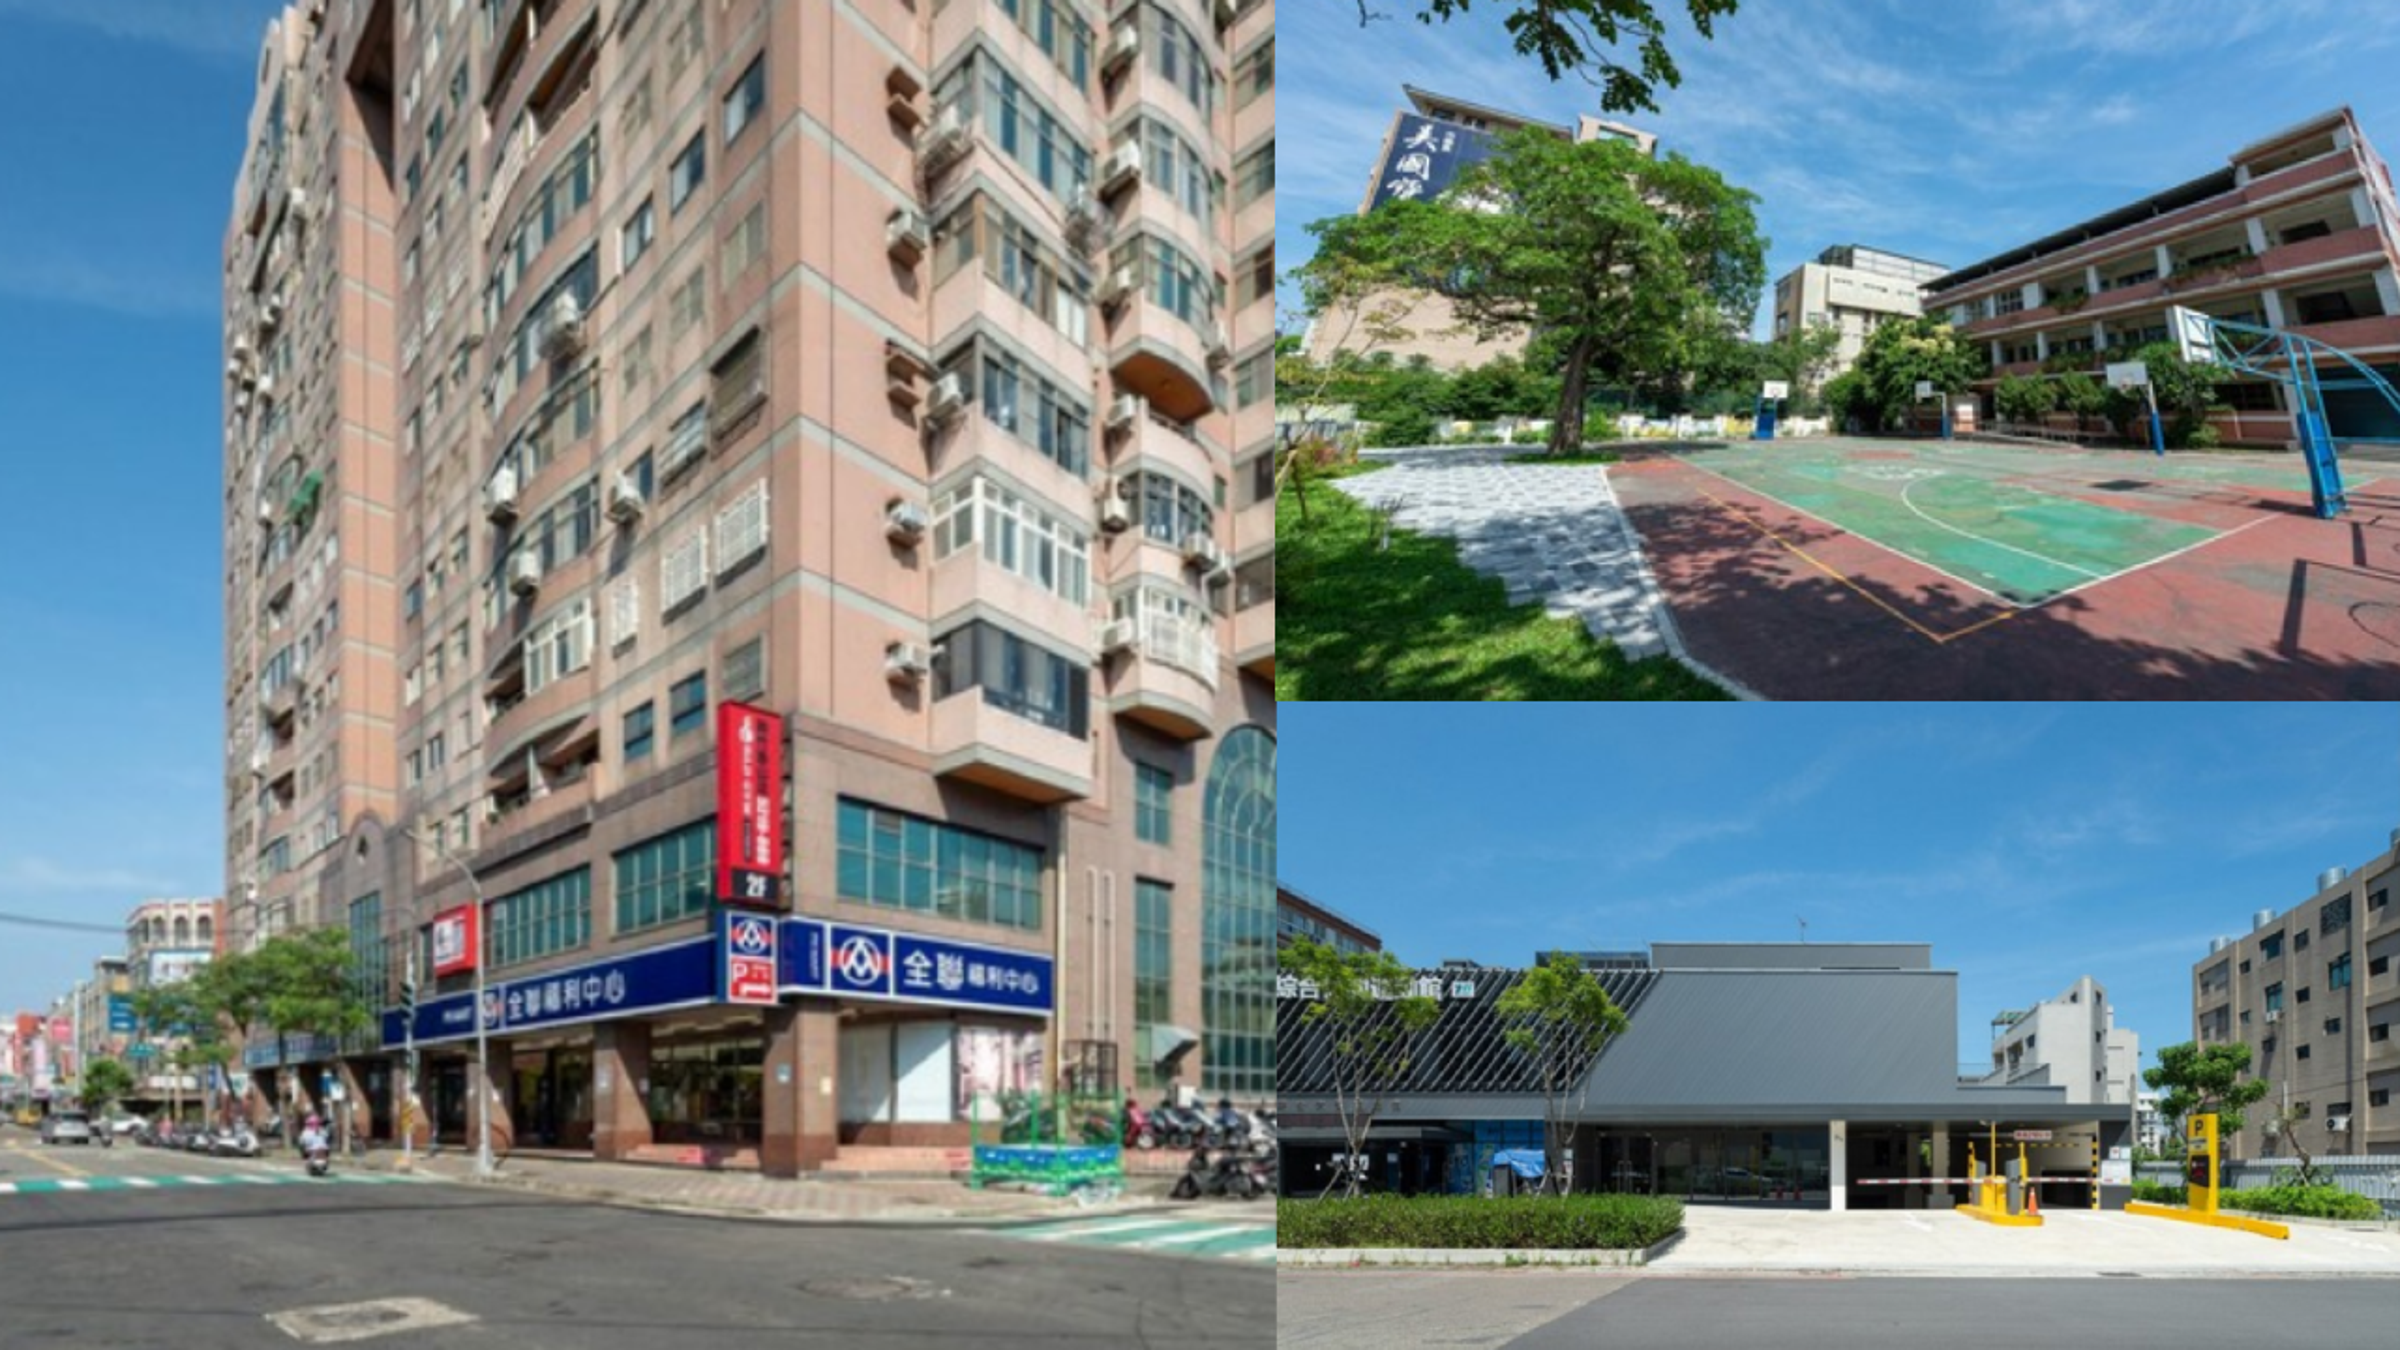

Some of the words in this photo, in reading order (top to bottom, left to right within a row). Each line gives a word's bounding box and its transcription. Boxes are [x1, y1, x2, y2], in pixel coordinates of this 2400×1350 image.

[745, 872, 767, 897] 2F
[732, 963, 748, 982] P
[903, 949, 1039, 995] 全聯福利中心
[508, 968, 626, 1021] 全聯福利中心
[2195, 1118, 2204, 1136] P
